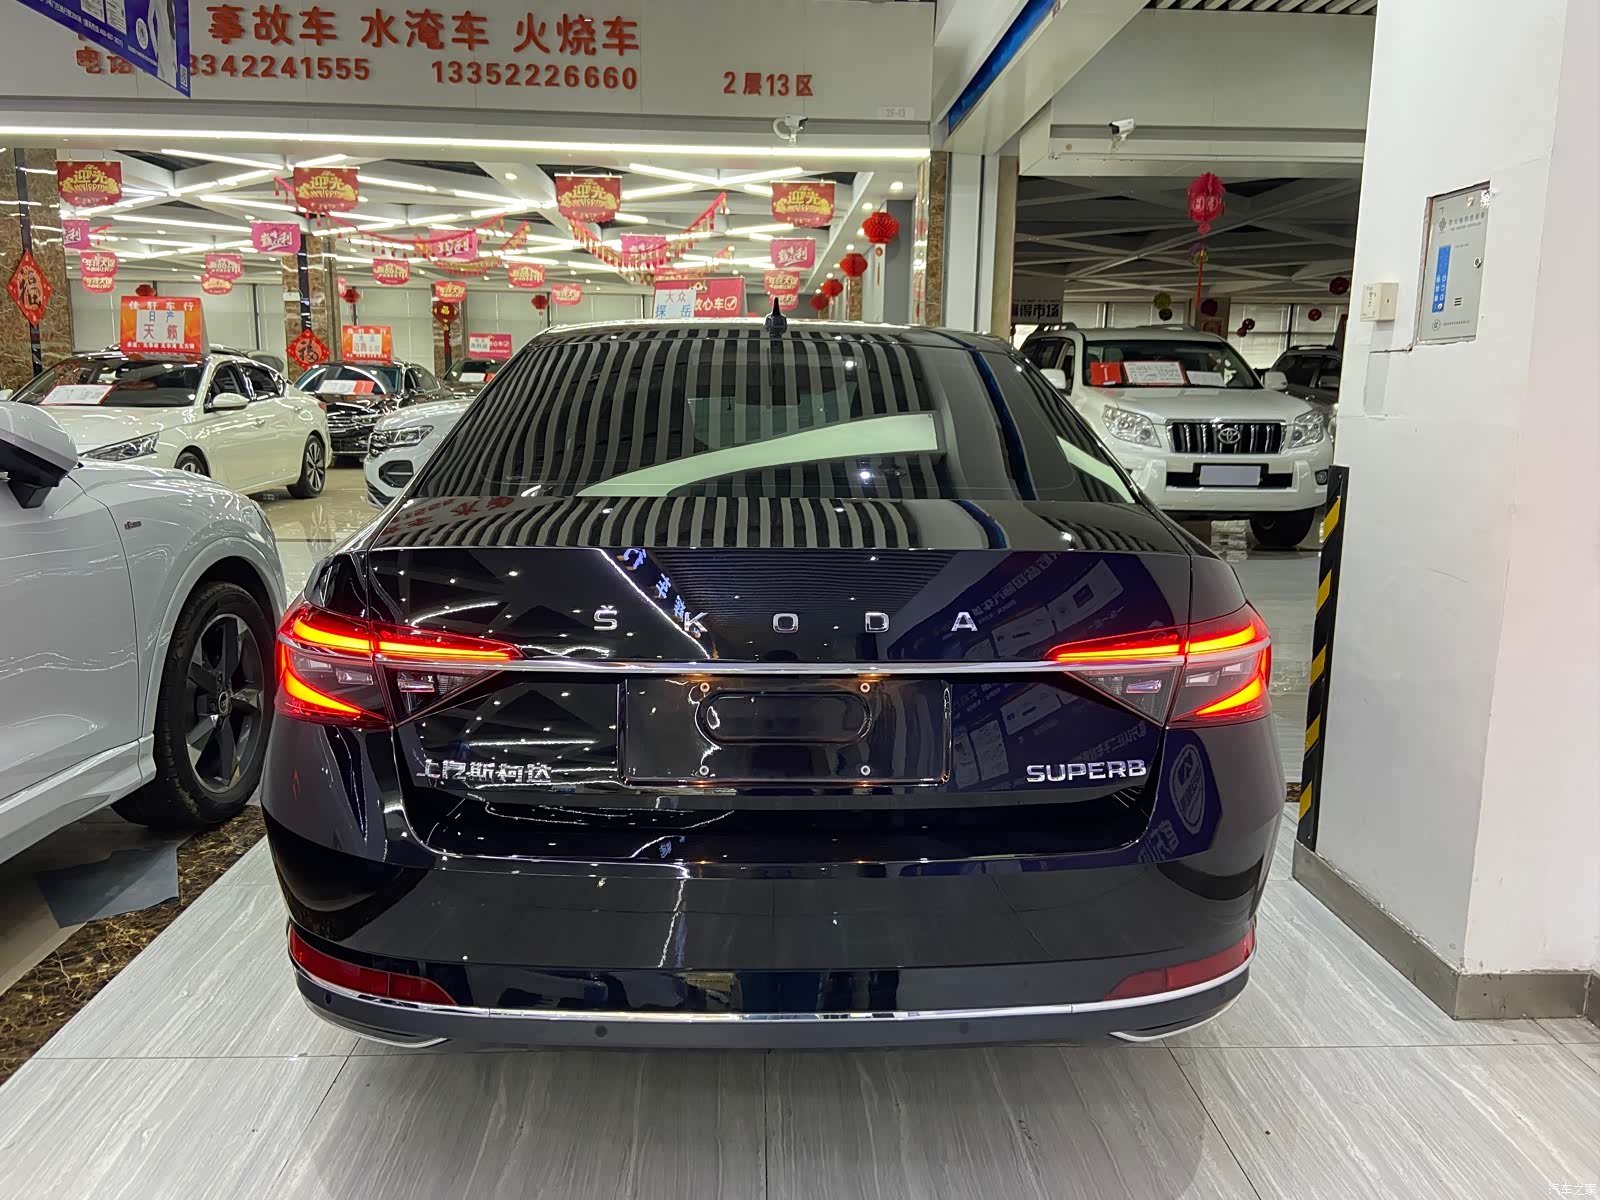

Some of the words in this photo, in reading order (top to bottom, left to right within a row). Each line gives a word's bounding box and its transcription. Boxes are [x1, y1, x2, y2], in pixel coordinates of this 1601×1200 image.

[207, 4, 337, 47] 事故车
[360, 8, 490, 51] 水淹车
[513, 12, 640, 57] 火烧车
[432, 60, 638, 91] 13352226660
[723, 70, 814, 98] 2层13区
[149, 310, 175, 322] 日产
[143, 323, 178, 340] 天籁
[593, 604, 979, 634] ŠKODA
[1026, 759, 1147, 783] SUPERB
